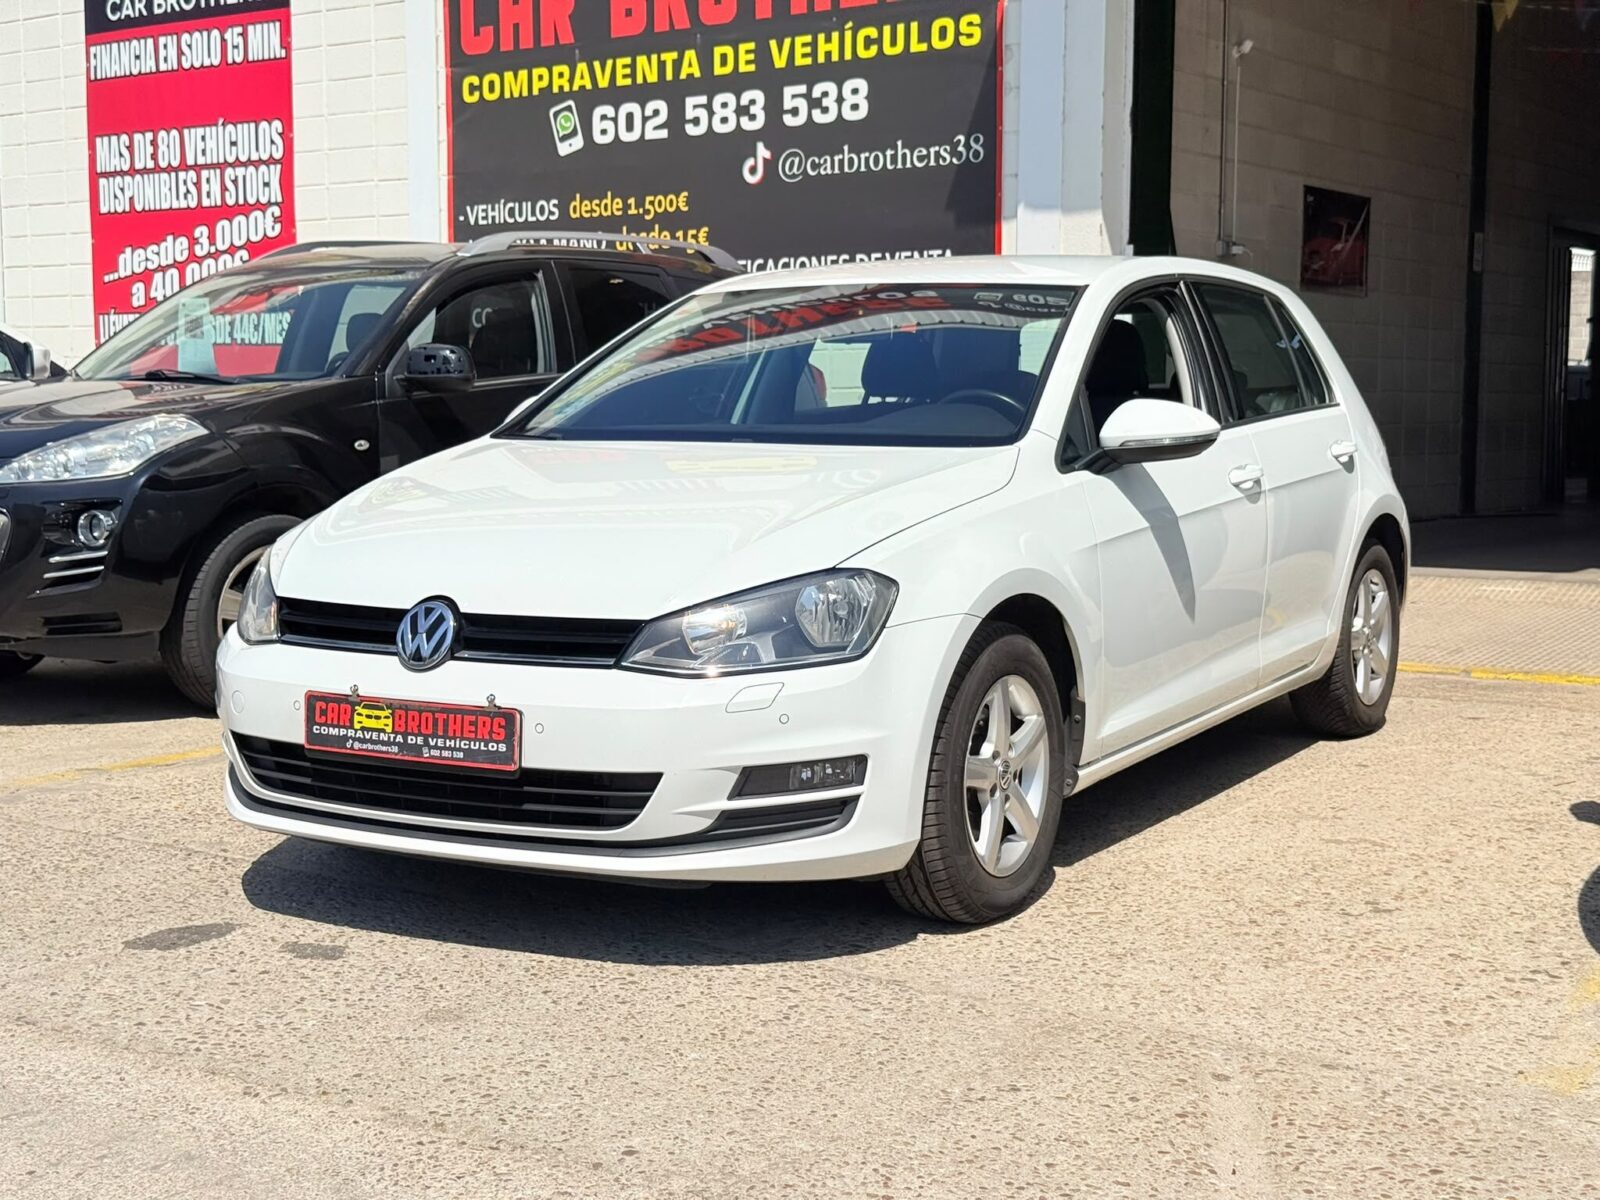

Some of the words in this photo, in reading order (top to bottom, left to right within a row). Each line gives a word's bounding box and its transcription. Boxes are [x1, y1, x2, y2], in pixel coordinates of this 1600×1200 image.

[106, 0, 147, 21] CAR
[460, 0, 575, 55] CAR
[90, 38, 156, 81] FINANCIA
[158, 34, 178, 72] EN
[180, 29, 222, 70] SOLO
[223, 26, 244, 64] 15
[247, 21, 286, 62] MIN.
[462, 49, 701, 104] COMPRAVENTA
[713, 41, 756, 76] DE
[769, 13, 982, 69] VEHÍCULOS
[591, 102, 669, 145] 602
[684, 90, 766, 137] 583
[783, 77, 869, 128] 538
[96, 134, 130, 173] MAS
[133, 131, 154, 169] DE
[157, 129, 180, 168] 80
[183, 118, 284, 166] VEHÍCULOS
[778, 134, 985, 184] @carbrothers38
[98, 171, 198, 214] DISPONIBLES
[201, 168, 222, 207] EN
[225, 164, 284, 206] STOCK
[569, 191, 623, 219] desde
[627, 191, 689, 220] 1.500€
[193, 206, 282, 257] 3.000€
[131, 281, 146, 309] a
[312, 726, 404, 744] COMPRAVENTA
[407, 735, 425, 746] DE
[428, 737, 507, 753] VEHÍCULOS
[314, 701, 352, 726] CAR
[393, 709, 506, 741] BROTHERS
